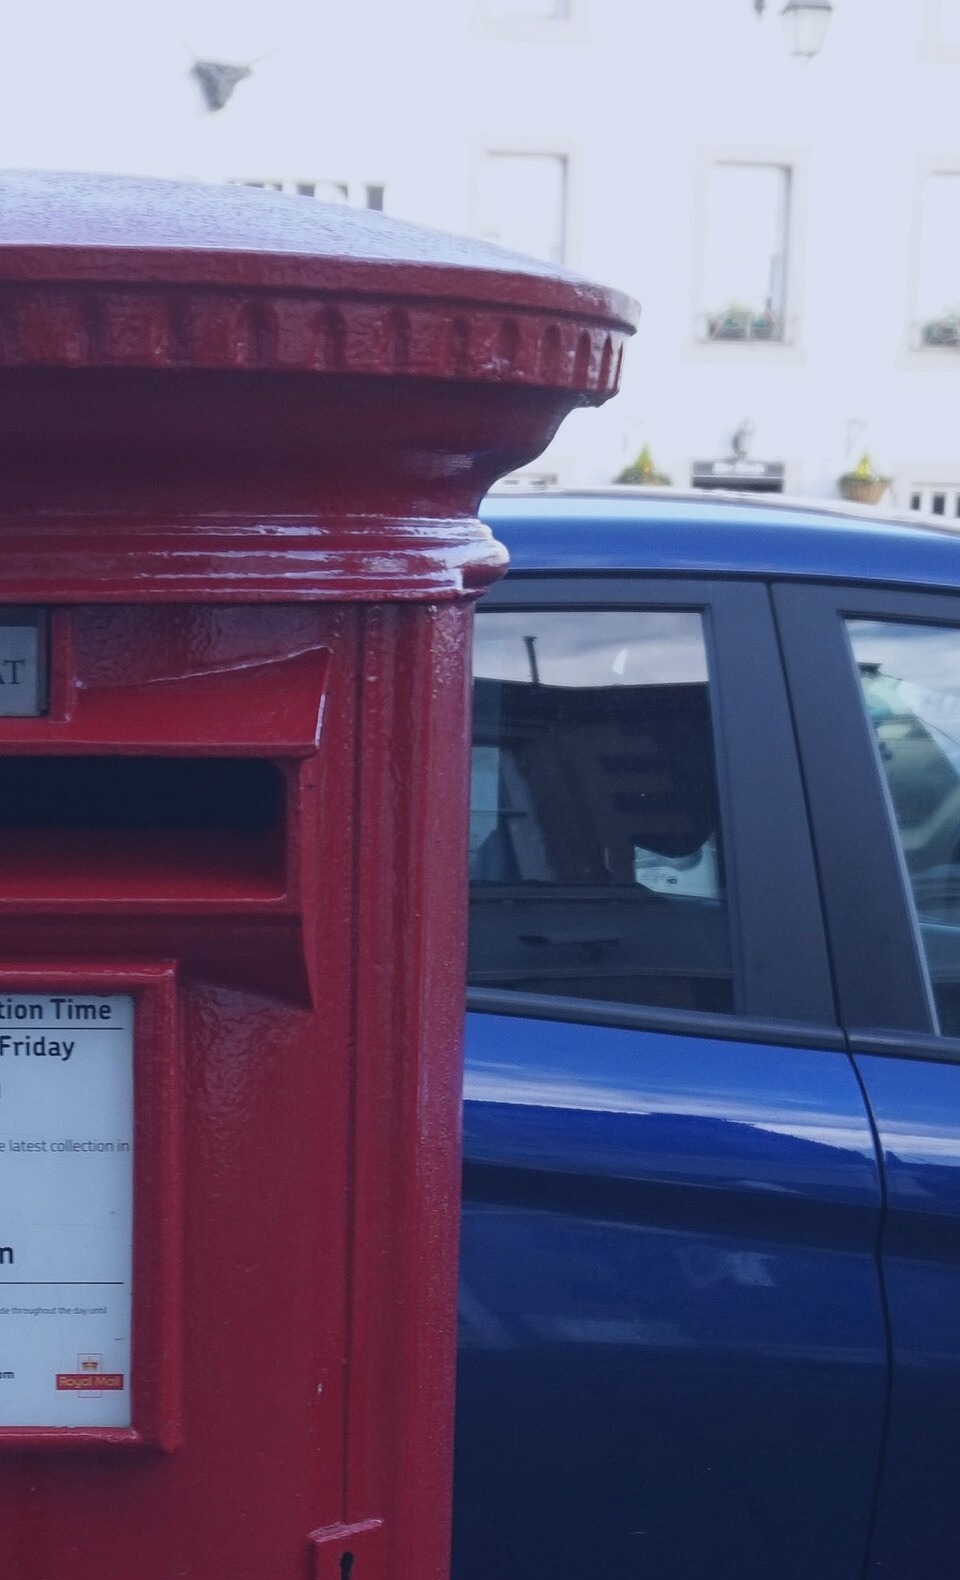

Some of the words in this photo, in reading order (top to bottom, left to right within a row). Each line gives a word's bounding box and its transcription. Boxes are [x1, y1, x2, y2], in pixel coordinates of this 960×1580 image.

[50, 998, 112, 1020] Time
[0, 1036, 74, 1061] Friday
[9, 1139, 47, 1152] latest
[50, 1139, 114, 1153] collection
[117, 1139, 130, 1152] in
[58, 1306, 72, 1315] the
[73, 1306, 88, 1316] day
